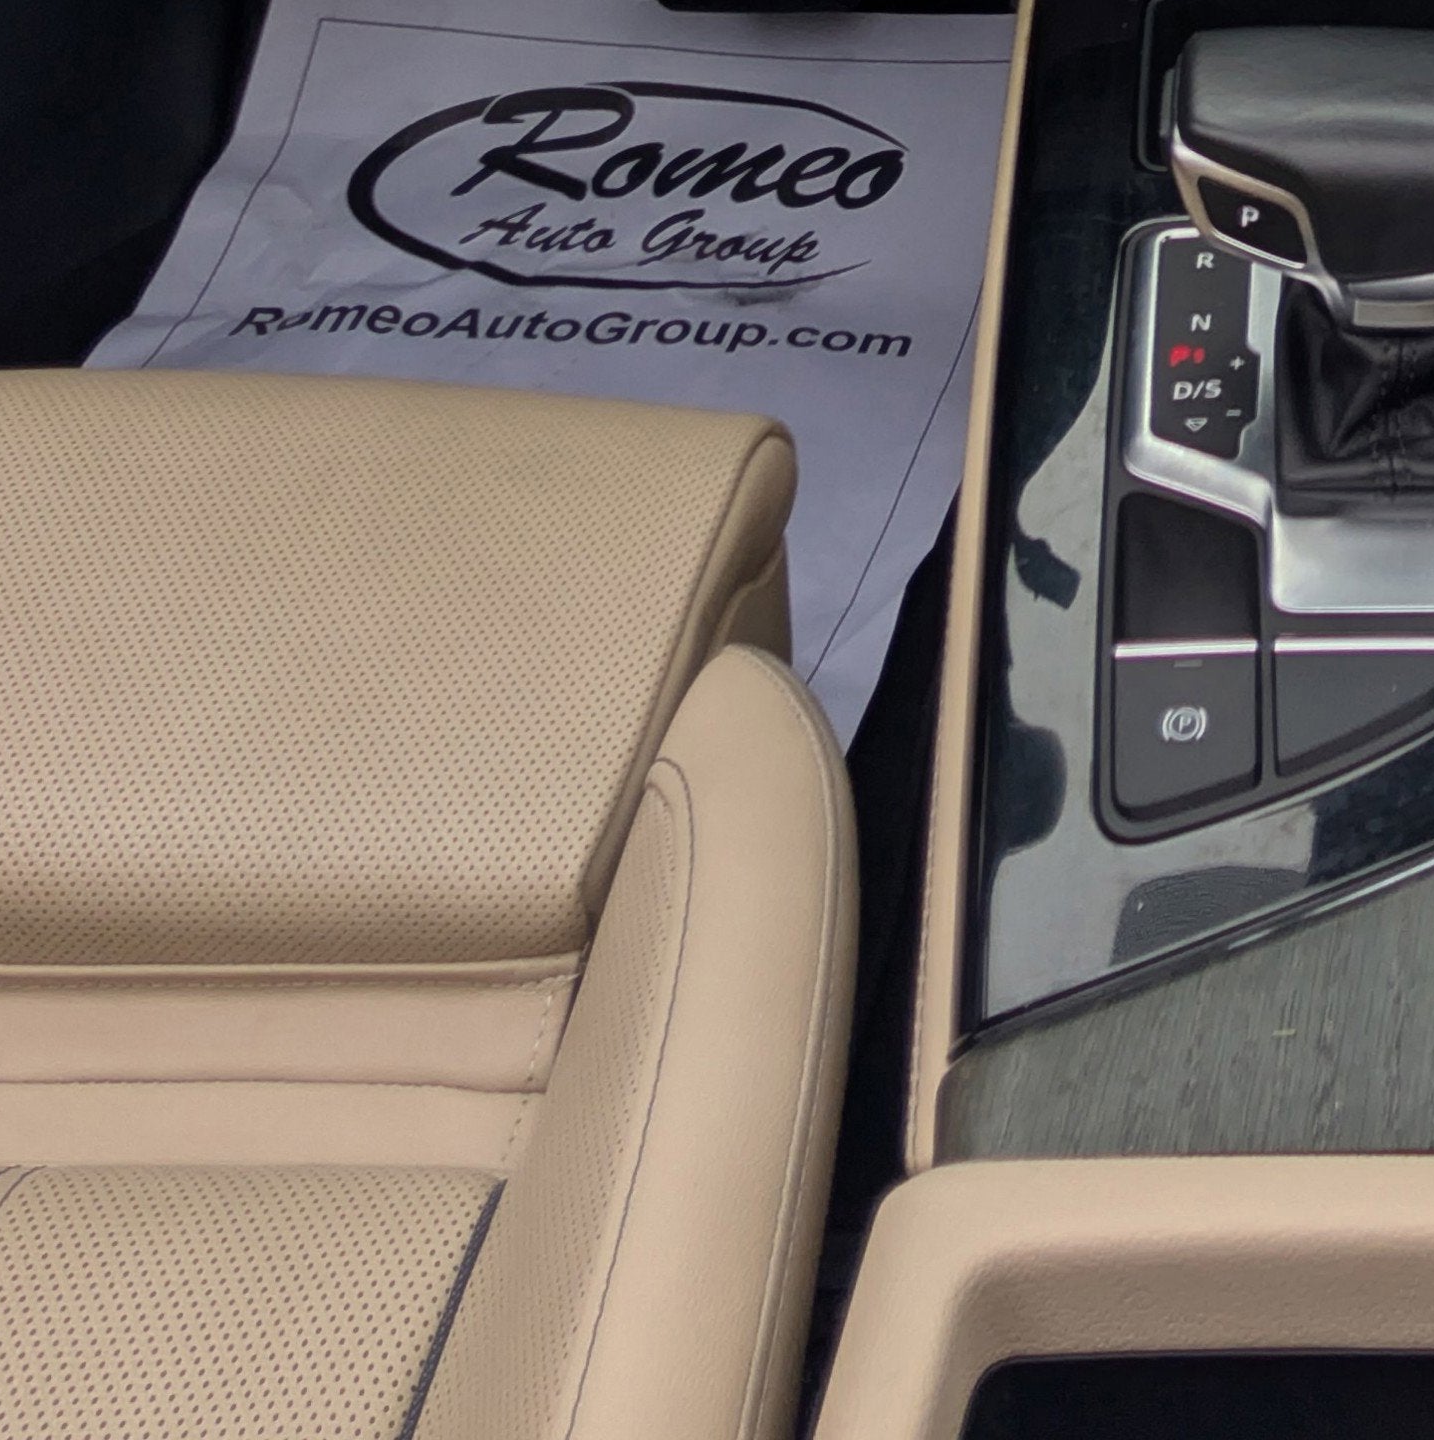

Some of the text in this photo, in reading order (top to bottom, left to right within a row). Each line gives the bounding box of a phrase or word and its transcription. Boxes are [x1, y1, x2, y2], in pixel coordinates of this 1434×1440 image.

[451, 86, 907, 210] Romeo
[1241, 204, 1260, 228] P
[460, 202, 823, 268] Auto Group
[1195, 251, 1215, 269] R
[229, 303, 913, 358] RomeoAutoGroup.com
[1190, 313, 1213, 332] N
[1172, 378, 1222, 401] D/S
